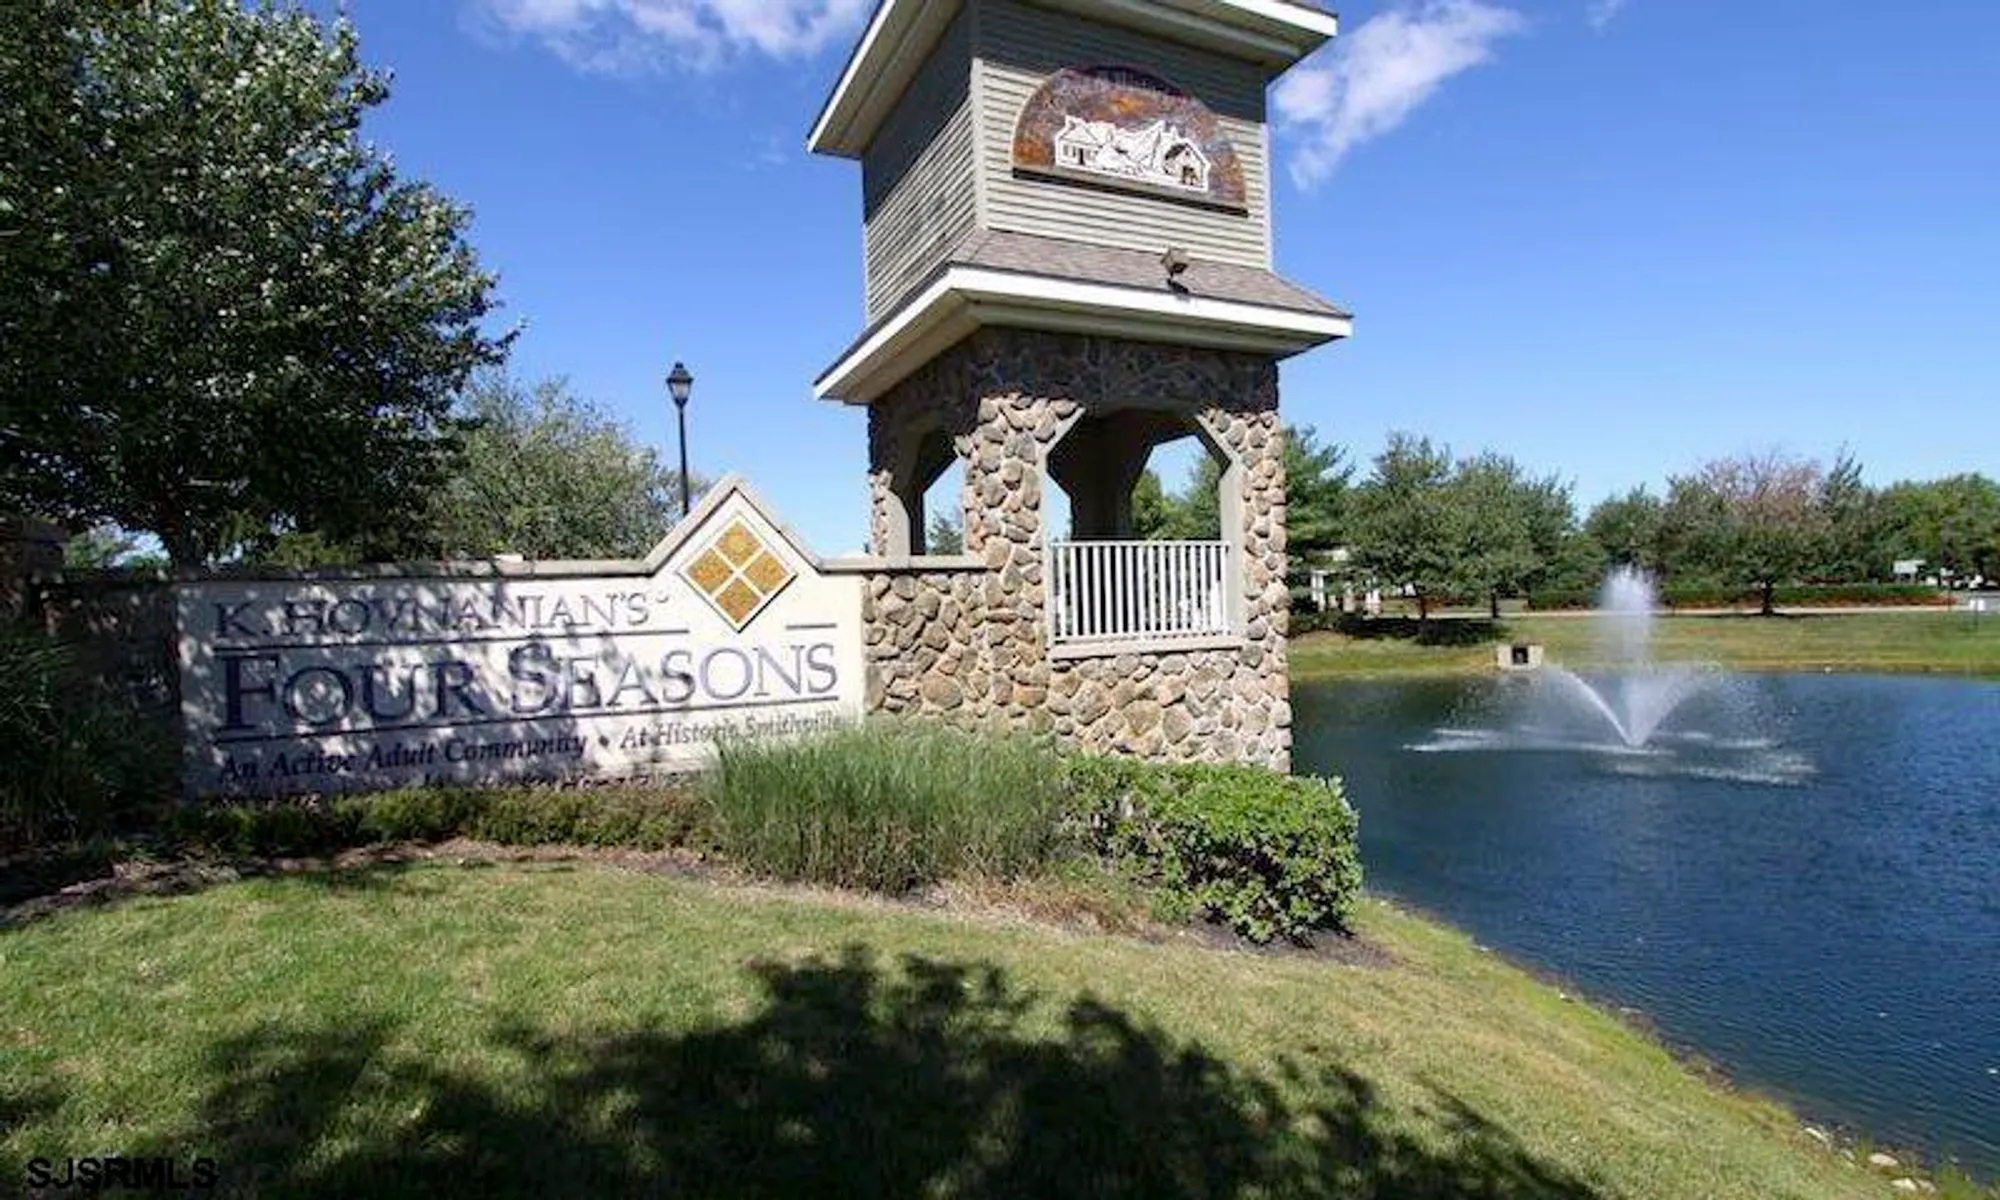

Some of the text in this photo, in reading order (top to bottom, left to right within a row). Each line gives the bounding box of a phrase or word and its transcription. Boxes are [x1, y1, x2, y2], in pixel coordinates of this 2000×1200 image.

[283, 592, 650, 637] HOVNANIAN'S
[215, 641, 838, 732] FOUR SEASONS
[220, 756, 258, 783] An
[366, 739, 435, 771] Adult
[445, 732, 587, 764] Community
[619, 725, 648, 750] At
